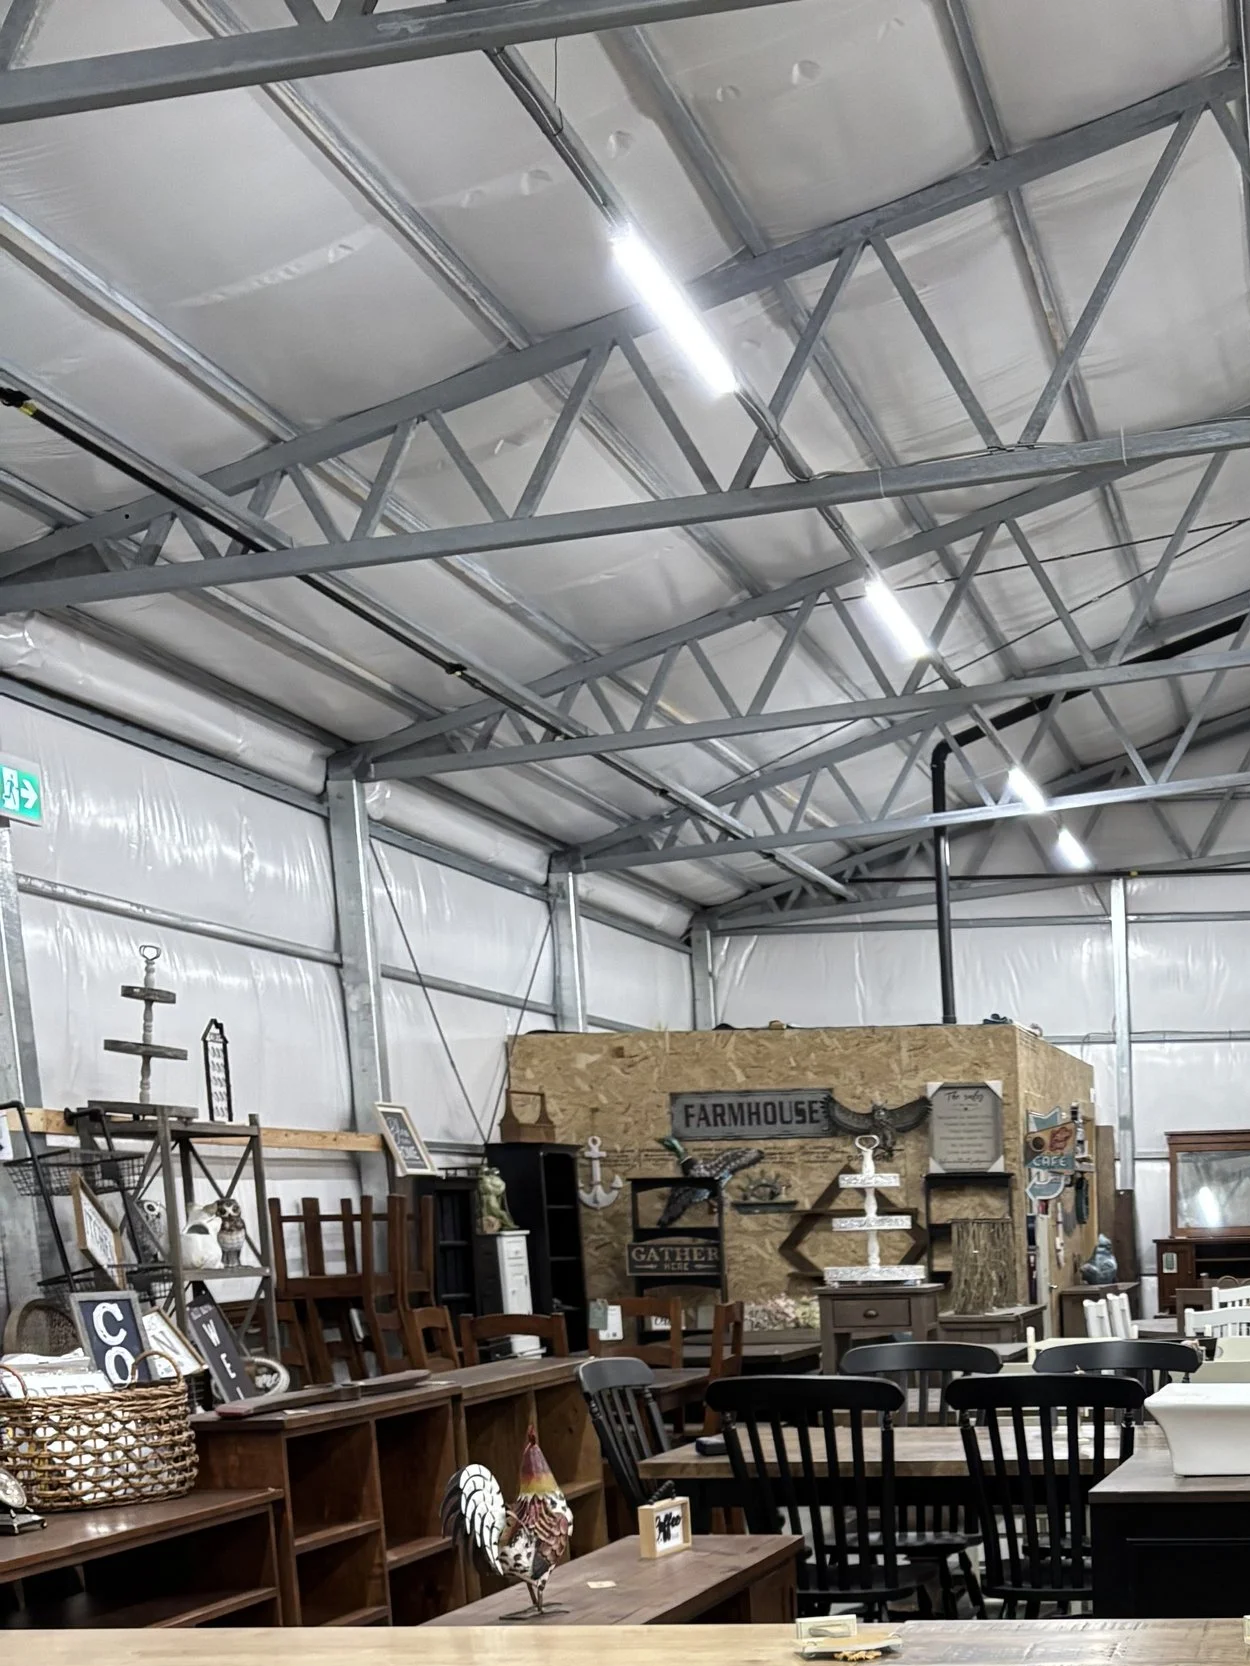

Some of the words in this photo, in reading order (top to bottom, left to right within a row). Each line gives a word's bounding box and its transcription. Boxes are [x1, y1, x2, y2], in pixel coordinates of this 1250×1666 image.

[683, 1100, 821, 1128] FARMHOUSE
[1032, 1155, 1068, 1167] CAFE
[631, 1247, 720, 1262] GATHER
